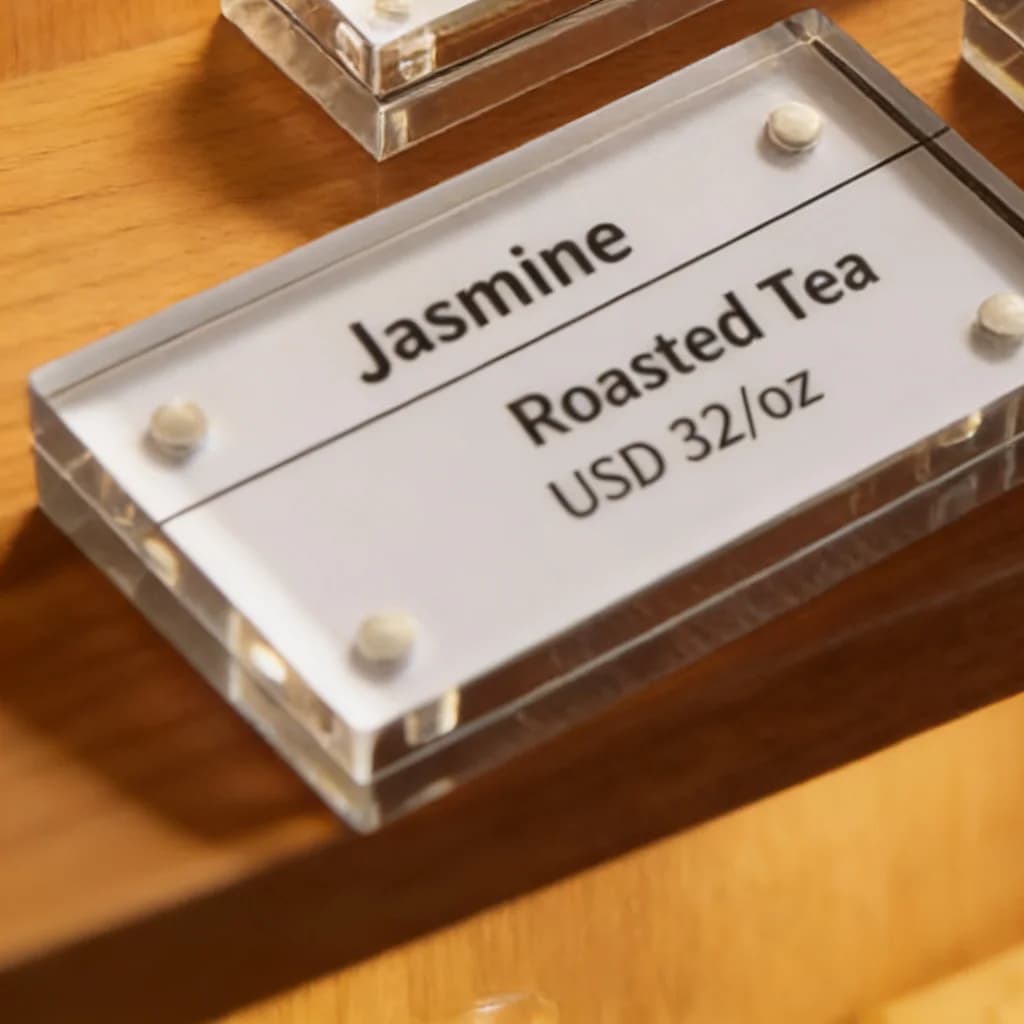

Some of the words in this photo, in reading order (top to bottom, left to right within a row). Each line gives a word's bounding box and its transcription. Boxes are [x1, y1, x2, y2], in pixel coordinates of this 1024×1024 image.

[348, 222, 633, 385] Jasmine
[505, 290, 765, 447] Roasted
[755, 253, 881, 321] Tea
[547, 441, 667, 520] USD
[668, 369, 825, 463] 32/oz
